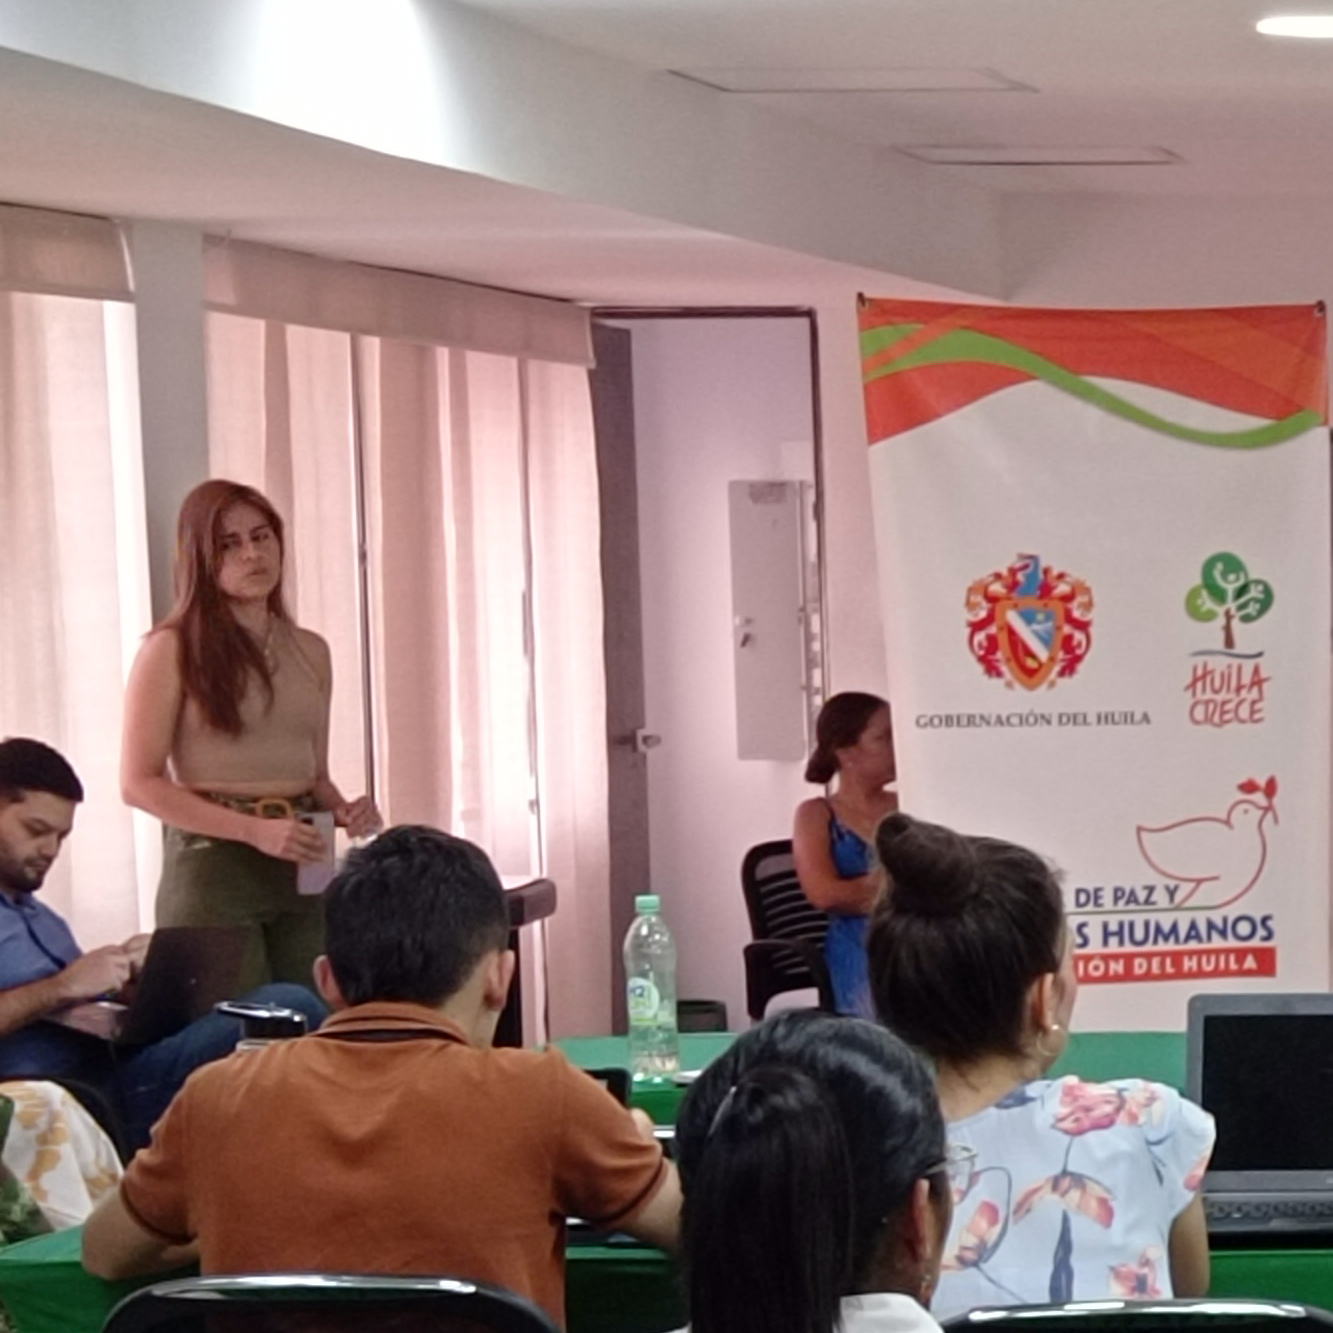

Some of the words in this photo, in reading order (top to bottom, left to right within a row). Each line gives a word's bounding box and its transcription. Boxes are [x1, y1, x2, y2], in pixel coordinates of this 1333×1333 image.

[915, 709, 1052, 729] GOBERNACIÓN
[1057, 711, 1093, 727] DEL
[1096, 710, 1152, 726] HUILA
[1188, 698, 1265, 728] CRECE
[1074, 886, 1105, 909] DE
[1112, 884, 1158, 907] PAZ
[1163, 883, 1180, 905] Y
[1101, 914, 1274, 948] HUMANOS
[1133, 955, 1175, 976] DEL
[1182, 952, 1258, 973] HUILA
